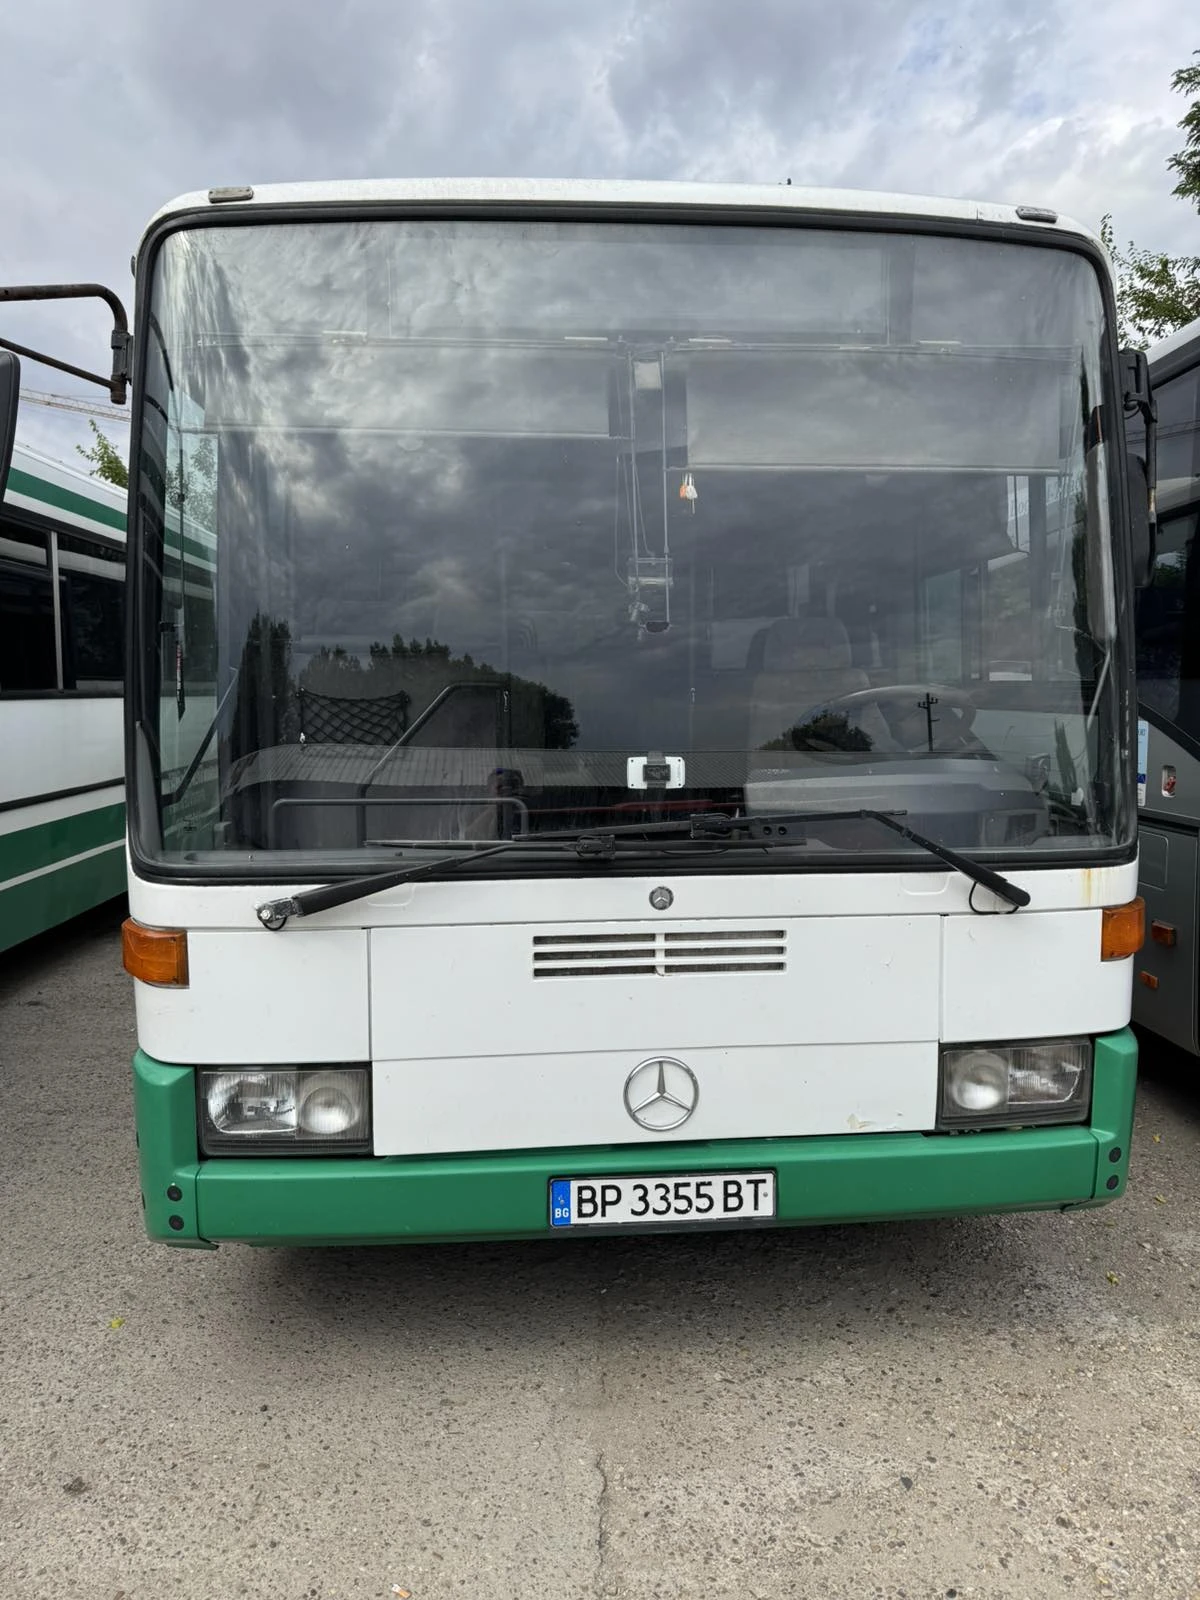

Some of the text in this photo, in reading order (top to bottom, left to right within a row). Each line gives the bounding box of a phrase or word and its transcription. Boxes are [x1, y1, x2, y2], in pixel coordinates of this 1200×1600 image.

[577, 1179, 767, 1219] BP 3355 BT
[554, 1208, 570, 1219] BG
